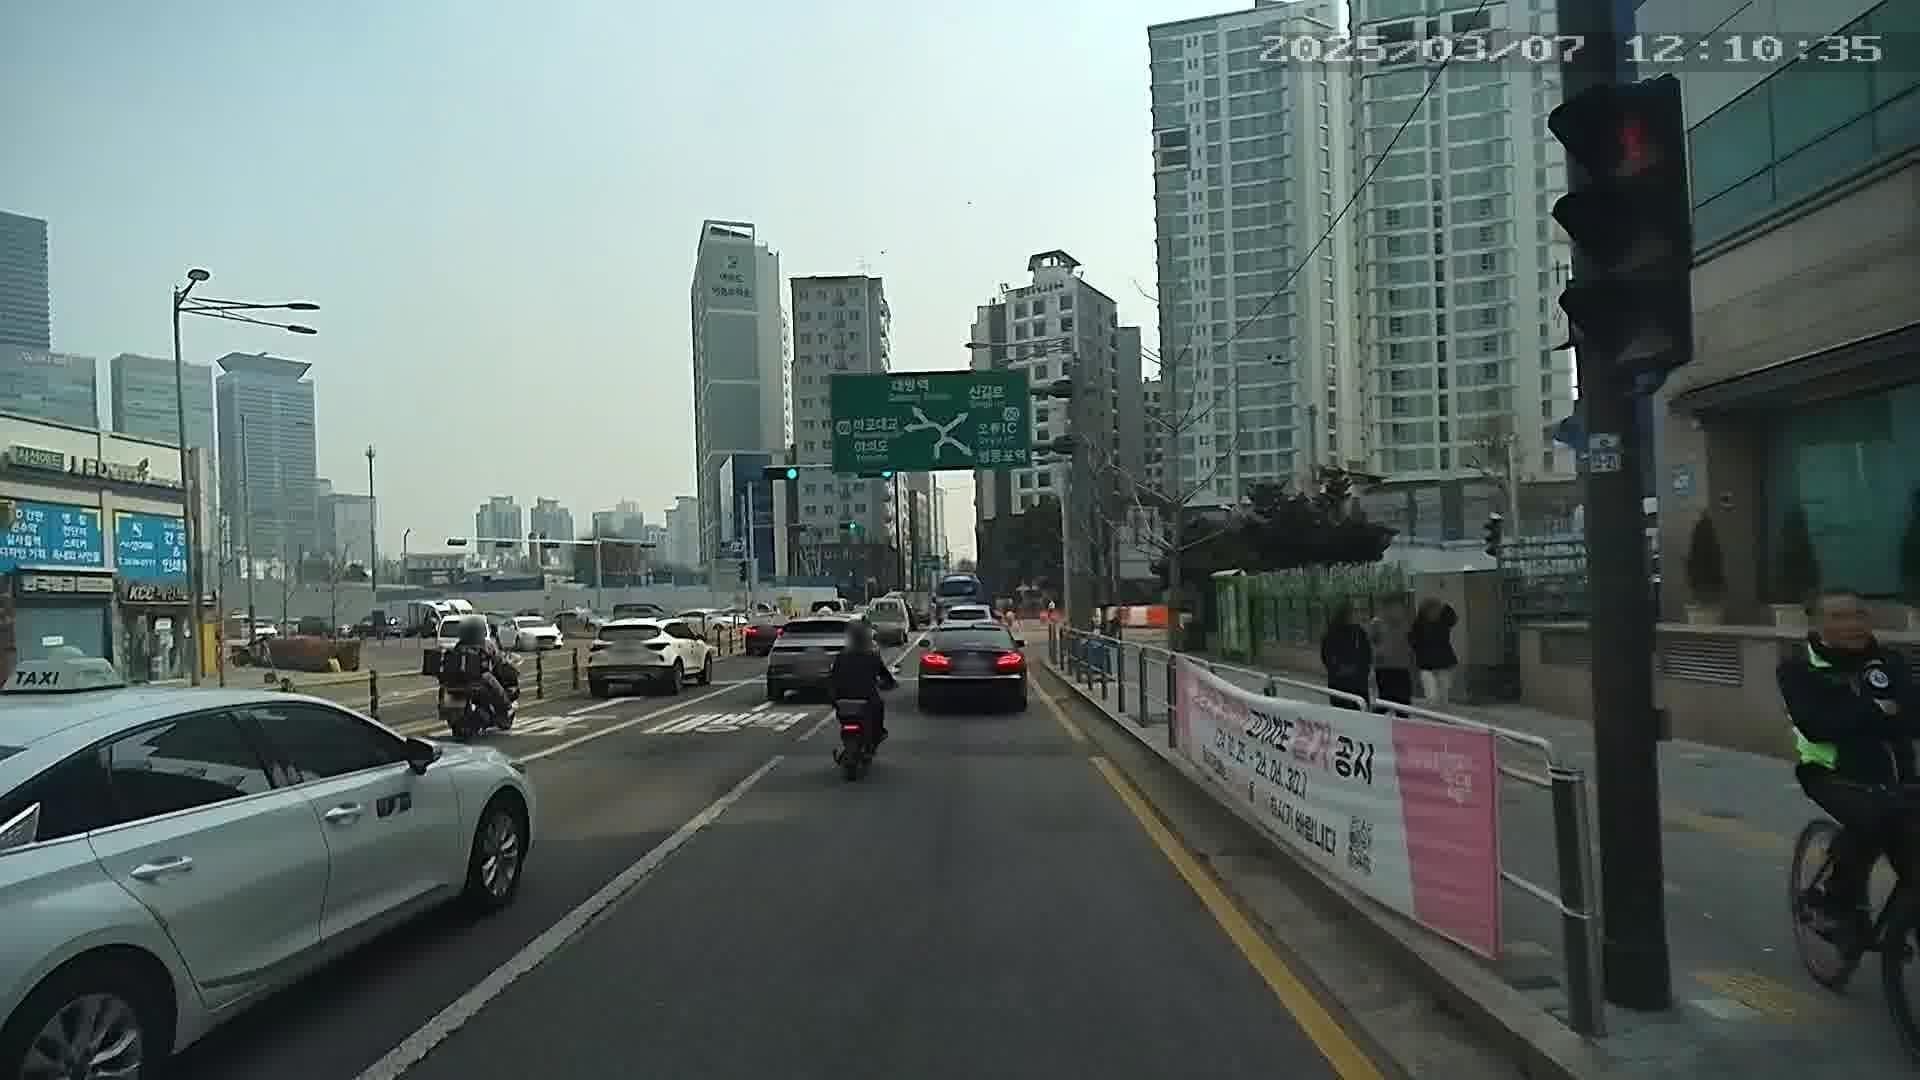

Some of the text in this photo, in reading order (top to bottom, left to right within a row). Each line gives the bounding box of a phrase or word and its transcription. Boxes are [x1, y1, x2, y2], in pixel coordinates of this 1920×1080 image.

[128, 584, 154, 600] KCC
[15, 671, 60, 686] TAXI
[1335, 735, 1376, 786] 공사
